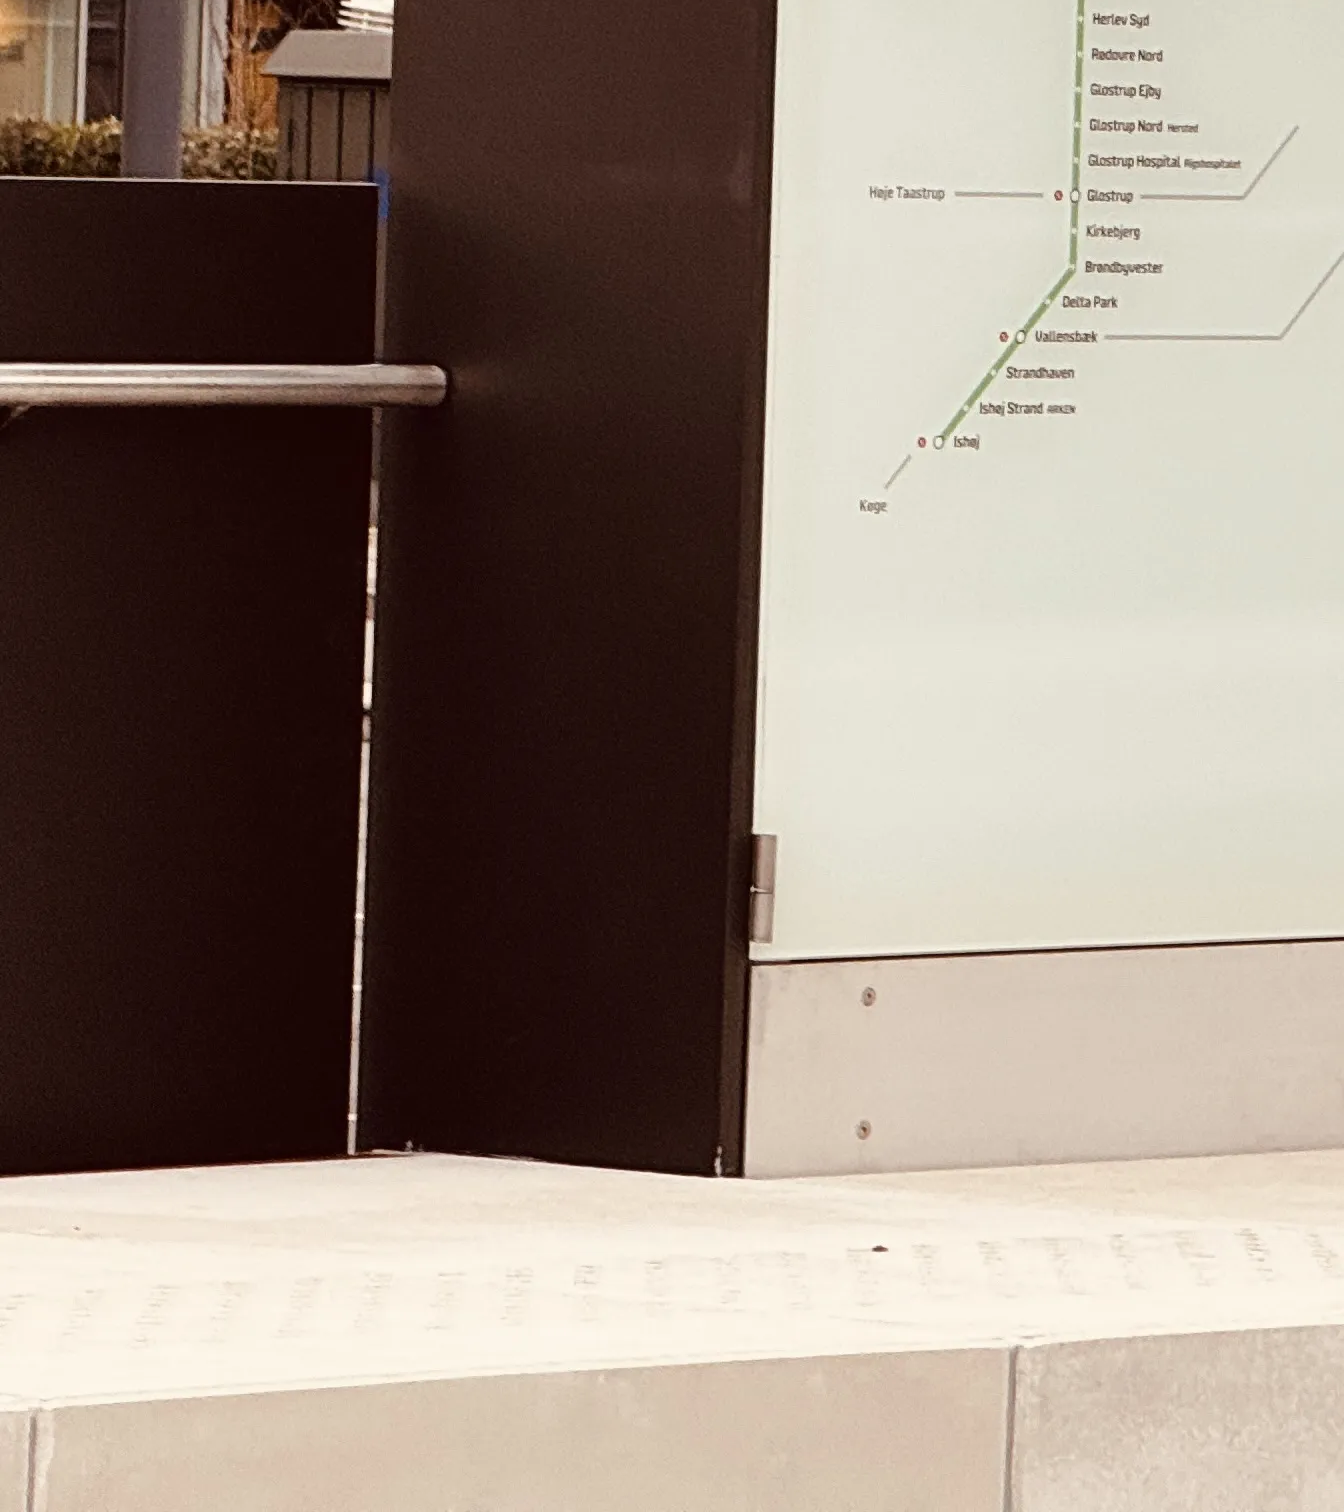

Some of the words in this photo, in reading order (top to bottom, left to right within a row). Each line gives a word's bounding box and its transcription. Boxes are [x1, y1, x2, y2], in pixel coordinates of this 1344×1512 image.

[1093, 13, 1125, 25] Herlev
[1129, 14, 1149, 28] Syd
[1138, 50, 1163, 62] Nord
[1090, 83, 1136, 98] Glostrup
[1139, 84, 1161, 100] Ejby
[1090, 119, 1135, 134] Glostrup
[1138, 120, 1163, 132] Nord
[1088, 154, 1134, 169] Glostrup
[1137, 155, 1181, 169] Hospital
[896, 186, 945, 201] Taastrup
[1087, 189, 1133, 204] Glostrup
[1086, 224, 1140, 240] Kirkebjerg
[1062, 296, 1091, 308] Delta
[1094, 296, 1118, 308] Park
[1006, 366, 1074, 379] Strandhaven
[1007, 402, 1044, 414] Strand
